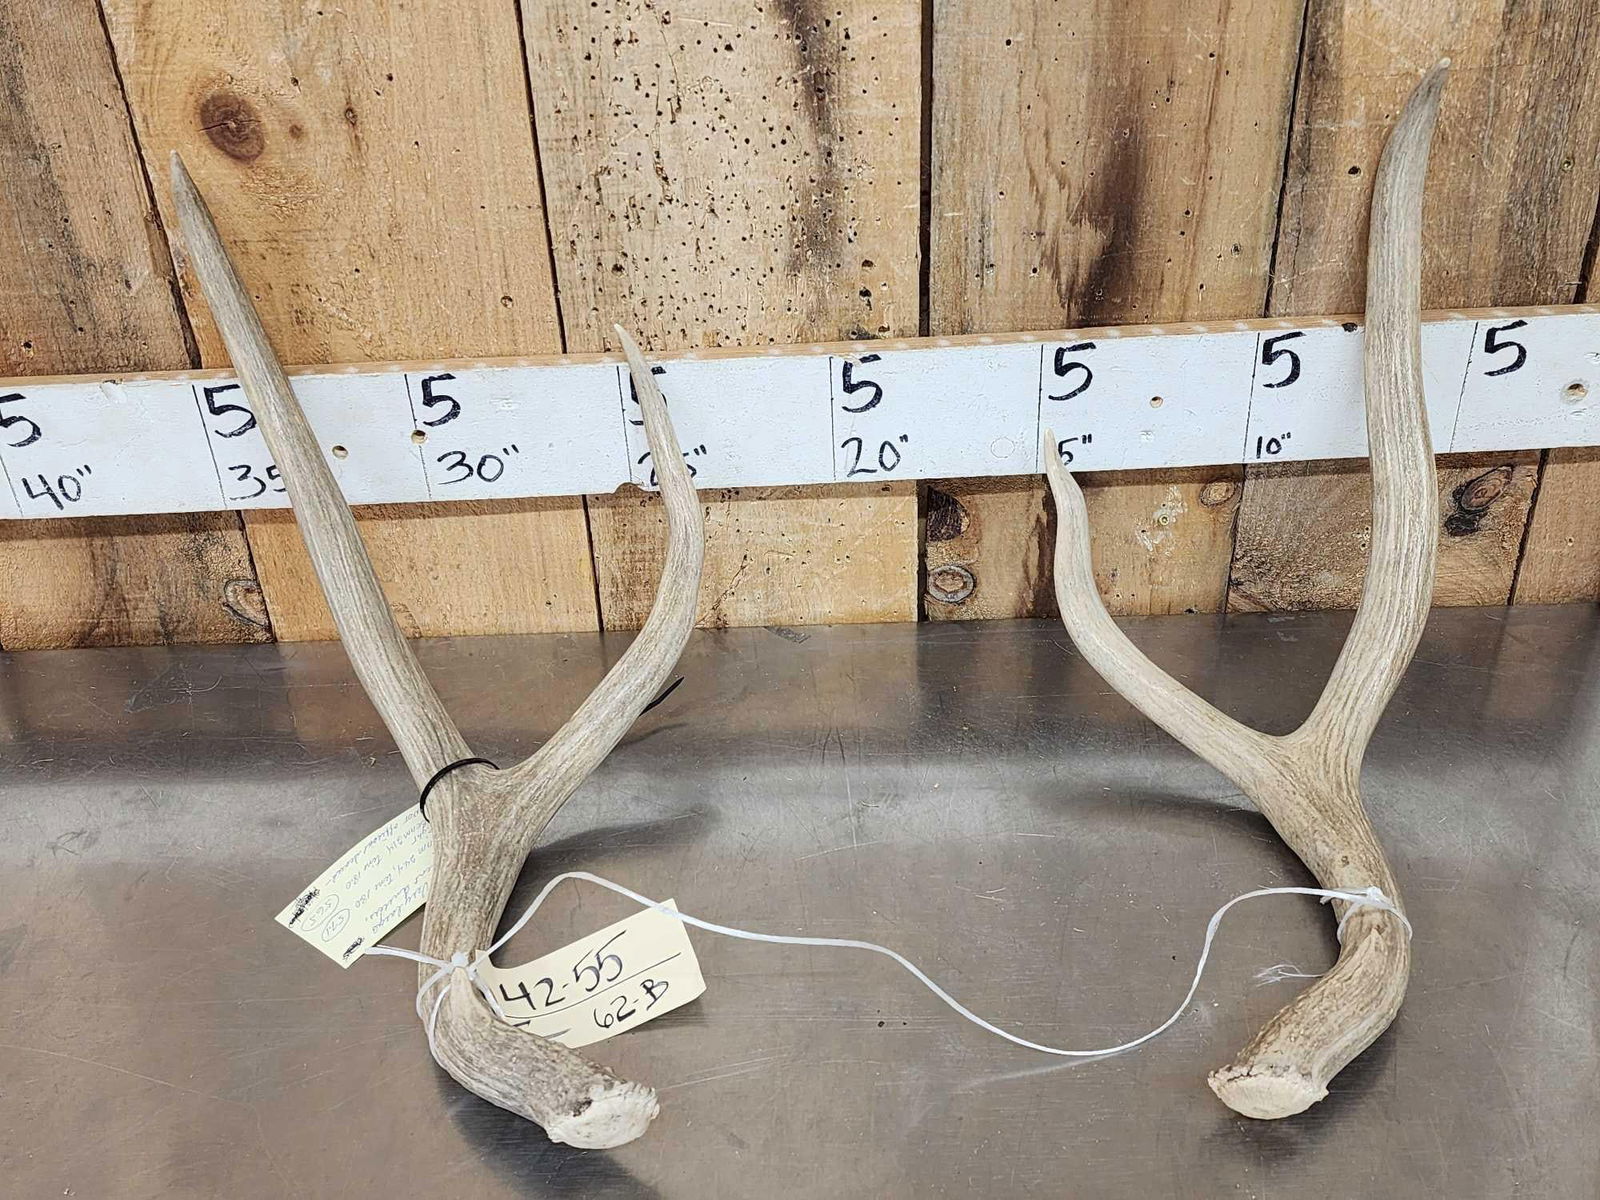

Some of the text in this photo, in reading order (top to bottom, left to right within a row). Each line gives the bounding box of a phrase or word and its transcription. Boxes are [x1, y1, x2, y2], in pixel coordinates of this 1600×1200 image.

[1048, 342, 1097, 401] 5
[1261, 331, 1306, 388] 5
[1483, 319, 1529, 377] 5
[422, 373, 461, 426] 5
[841, 354, 883, 413] 5
[0, 393, 42, 447] 5
[204, 384, 257, 438] 5
[437, 444, 519, 485] 30"
[841, 434, 909, 478] 20"
[1255, 432, 1294, 461] 10"
[22, 464, 92, 511] 40"
[500, 930, 626, 1010] 42-55
[594, 978, 668, 1028] 62-B
